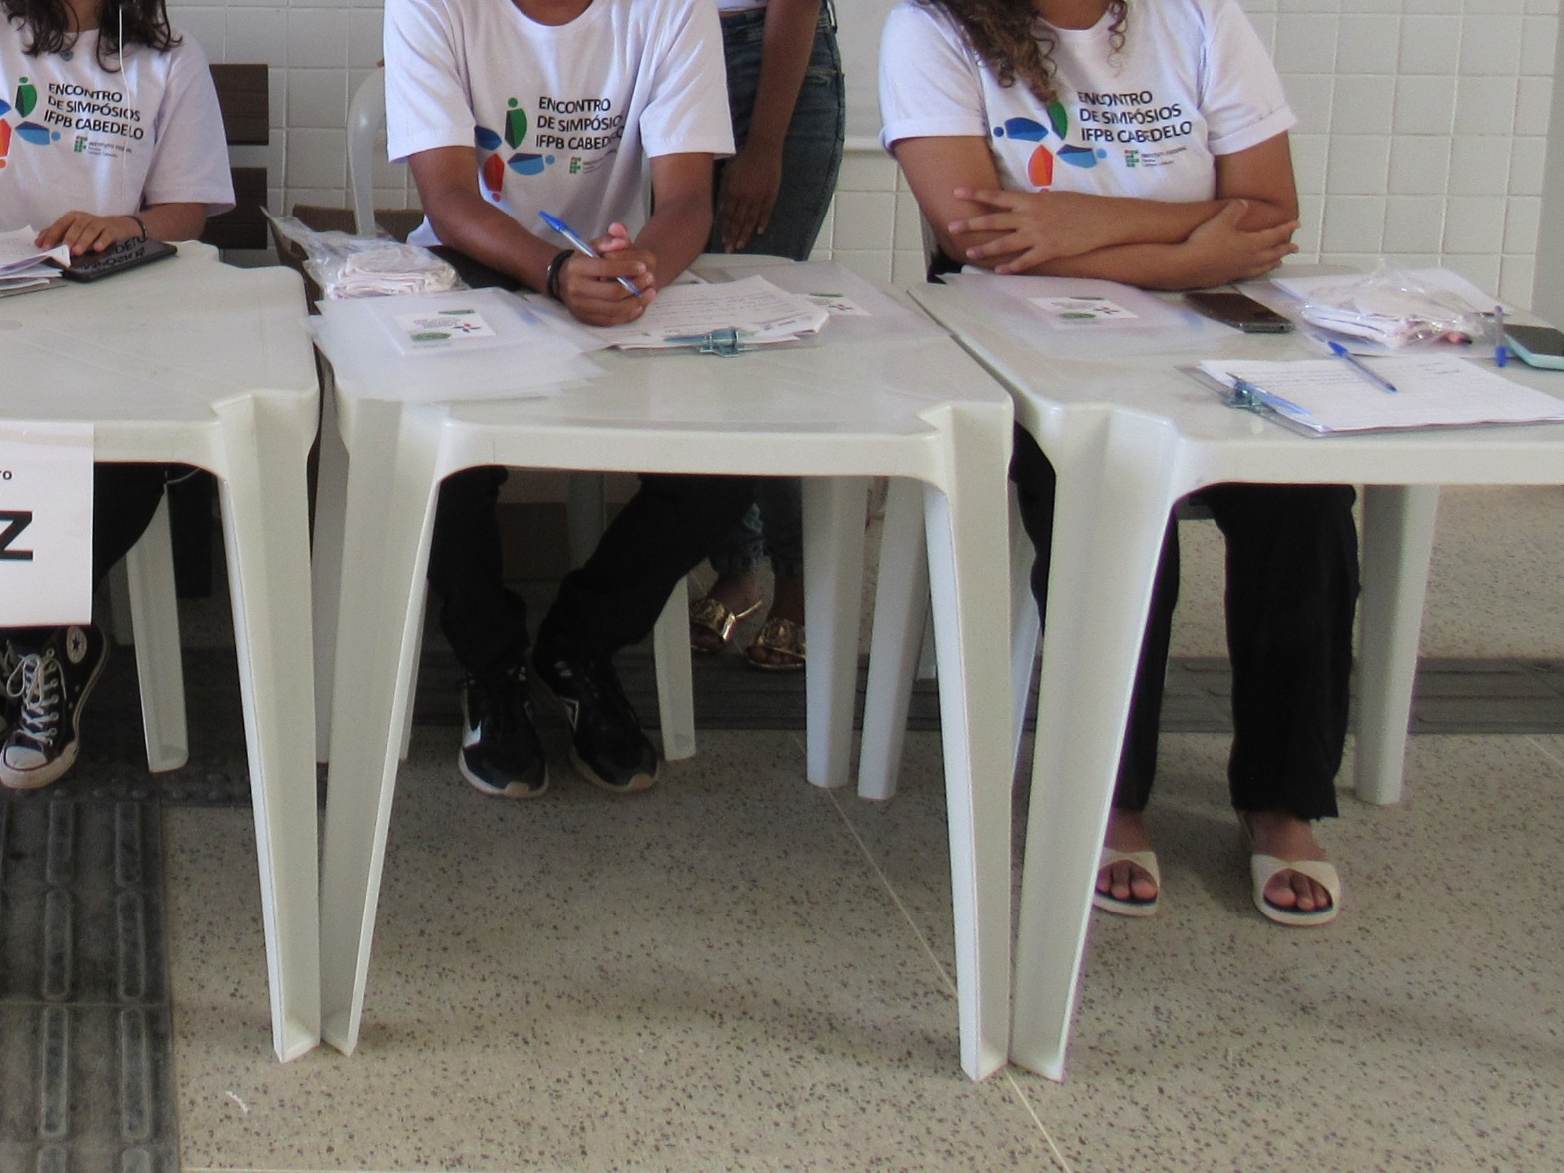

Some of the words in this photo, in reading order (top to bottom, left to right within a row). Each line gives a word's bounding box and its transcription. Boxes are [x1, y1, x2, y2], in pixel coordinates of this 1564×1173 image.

[48, 82, 123, 102] ENCONTRO
[1077, 91, 1153, 106] ENCONTRO
[47, 96, 65, 111] DE
[66, 100, 141, 123] SIMPÓSIOS
[538, 97, 612, 114] ENCONTRO
[1079, 108, 1100, 122] DE
[1102, 103, 1182, 125] SIMPÓSIOS
[44, 109, 73, 129] IFPB
[75, 115, 144, 140] CABEDELO
[537, 116, 555, 129] DE
[557, 114, 623, 132] SIMPÓSIO
[1081, 128, 1114, 143] IFPB
[1117, 120, 1193, 143] CABEDELO
[536, 135, 564, 149] IFPB
